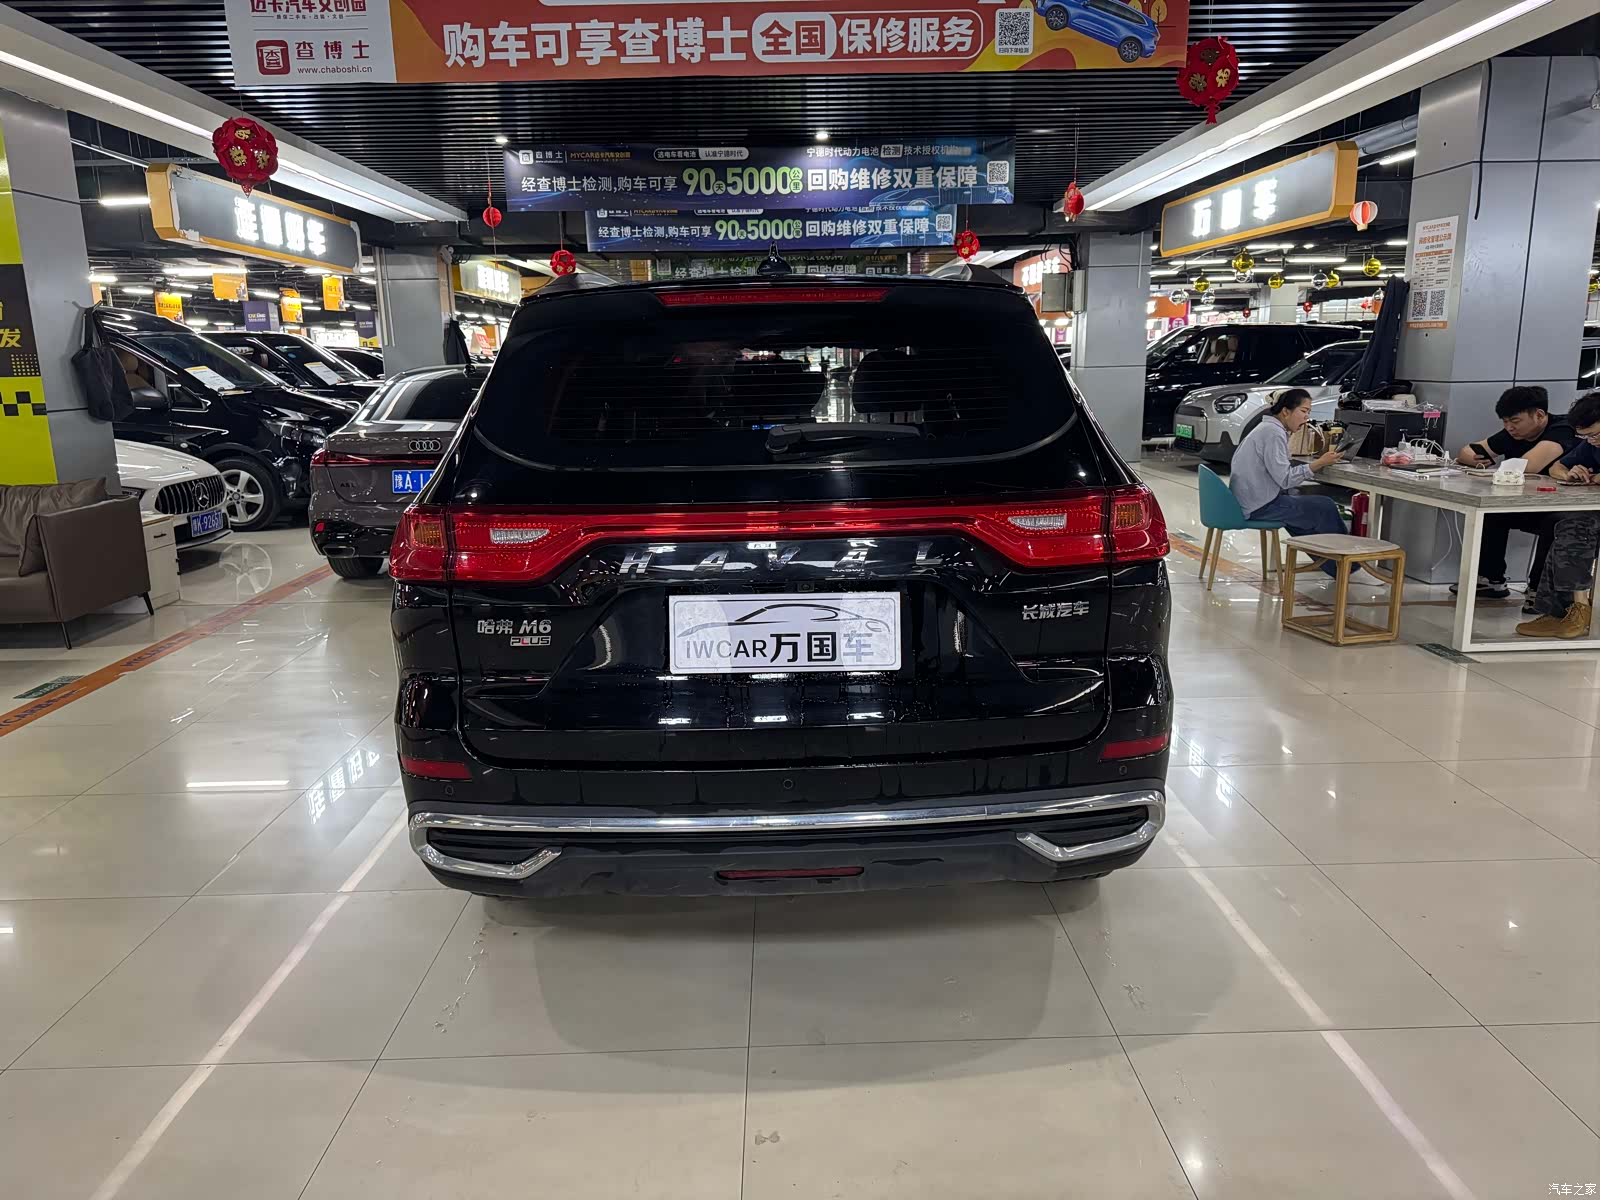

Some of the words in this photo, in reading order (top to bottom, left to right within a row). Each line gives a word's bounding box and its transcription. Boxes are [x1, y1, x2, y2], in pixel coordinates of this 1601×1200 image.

[294, 40, 370, 60] 查博士
[297, 65, 373, 74] www.chaboshi.cn
[807, 165, 978, 191] 回购维修双重保障
[805, 217, 930, 238] 回购维修双重保障
[618, 543, 943, 575] HAVAL
[1021, 601, 1090, 621] 长城汽车
[477, 619, 513, 635] 哈弗
[519, 619, 552, 635] M6
[510, 636, 551, 646] PLUS
